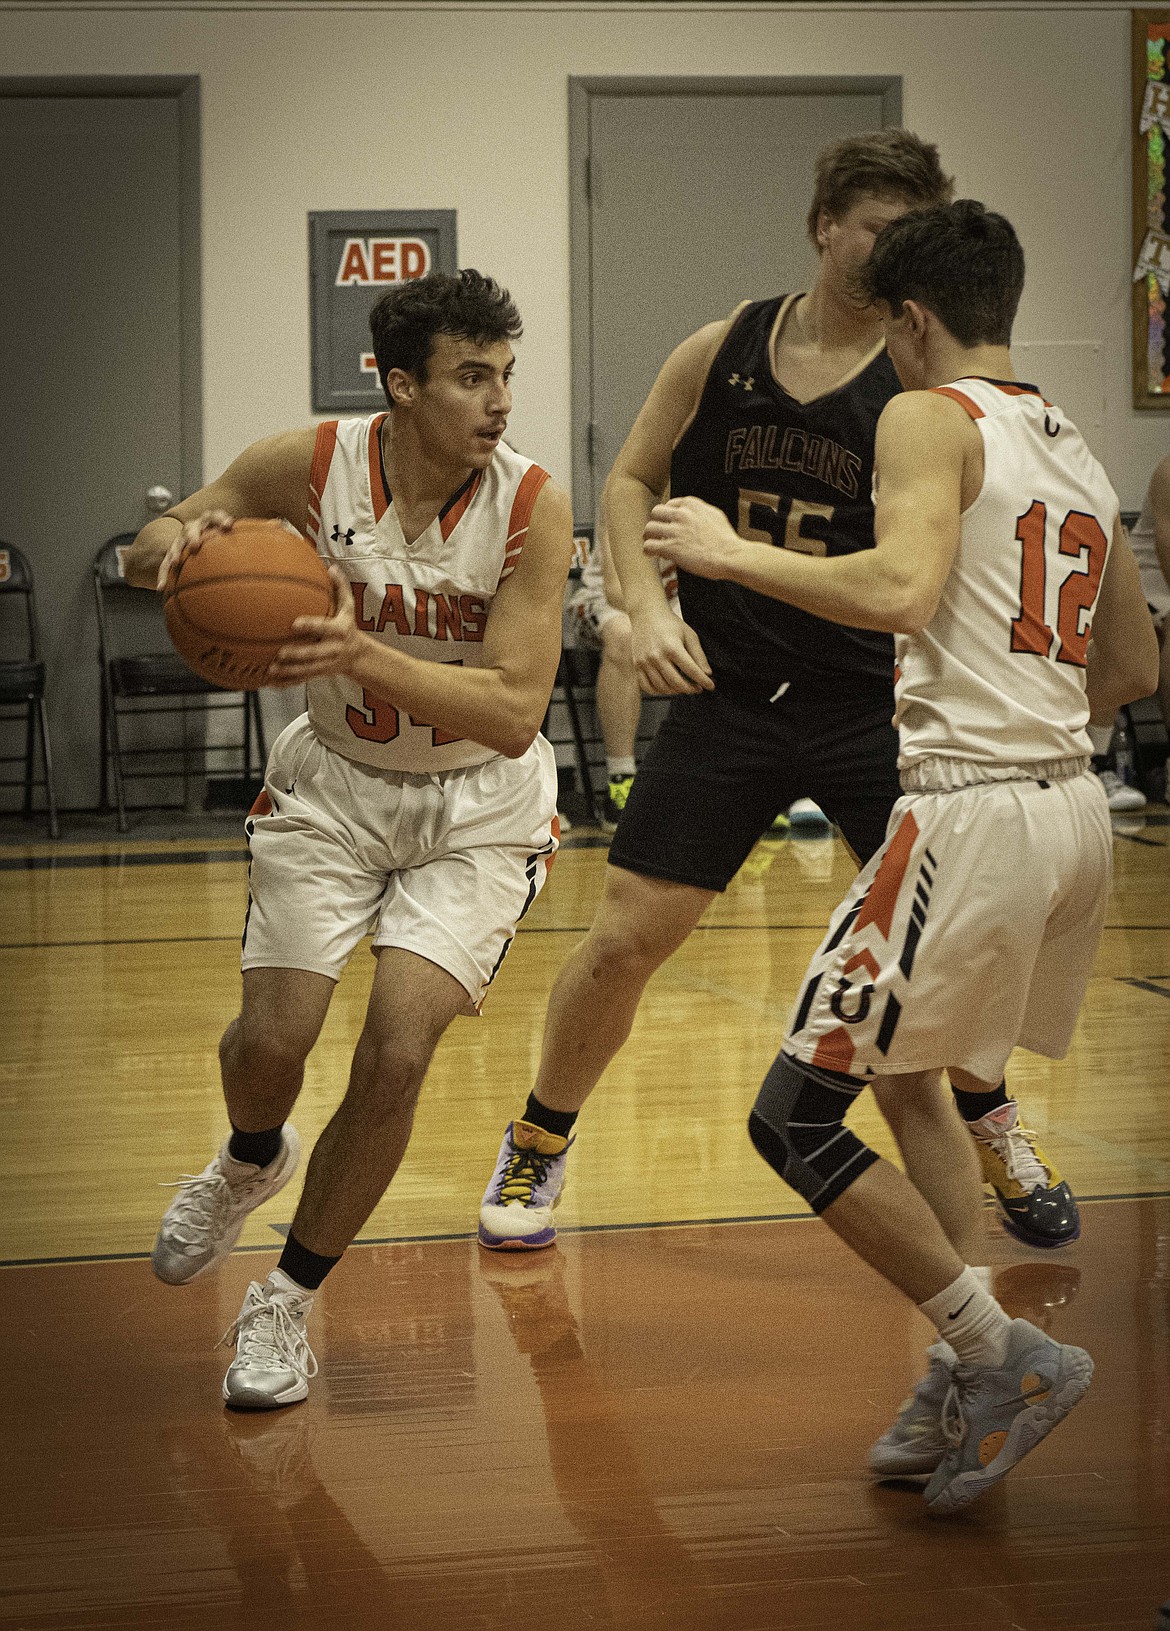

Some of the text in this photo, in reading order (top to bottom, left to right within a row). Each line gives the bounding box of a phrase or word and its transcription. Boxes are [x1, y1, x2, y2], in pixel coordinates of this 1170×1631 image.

[337, 239, 429, 284] AED
[725, 425, 862, 499] FALCONS
[350, 582, 488, 643] LAINS
[1010, 499, 1108, 668] 12
